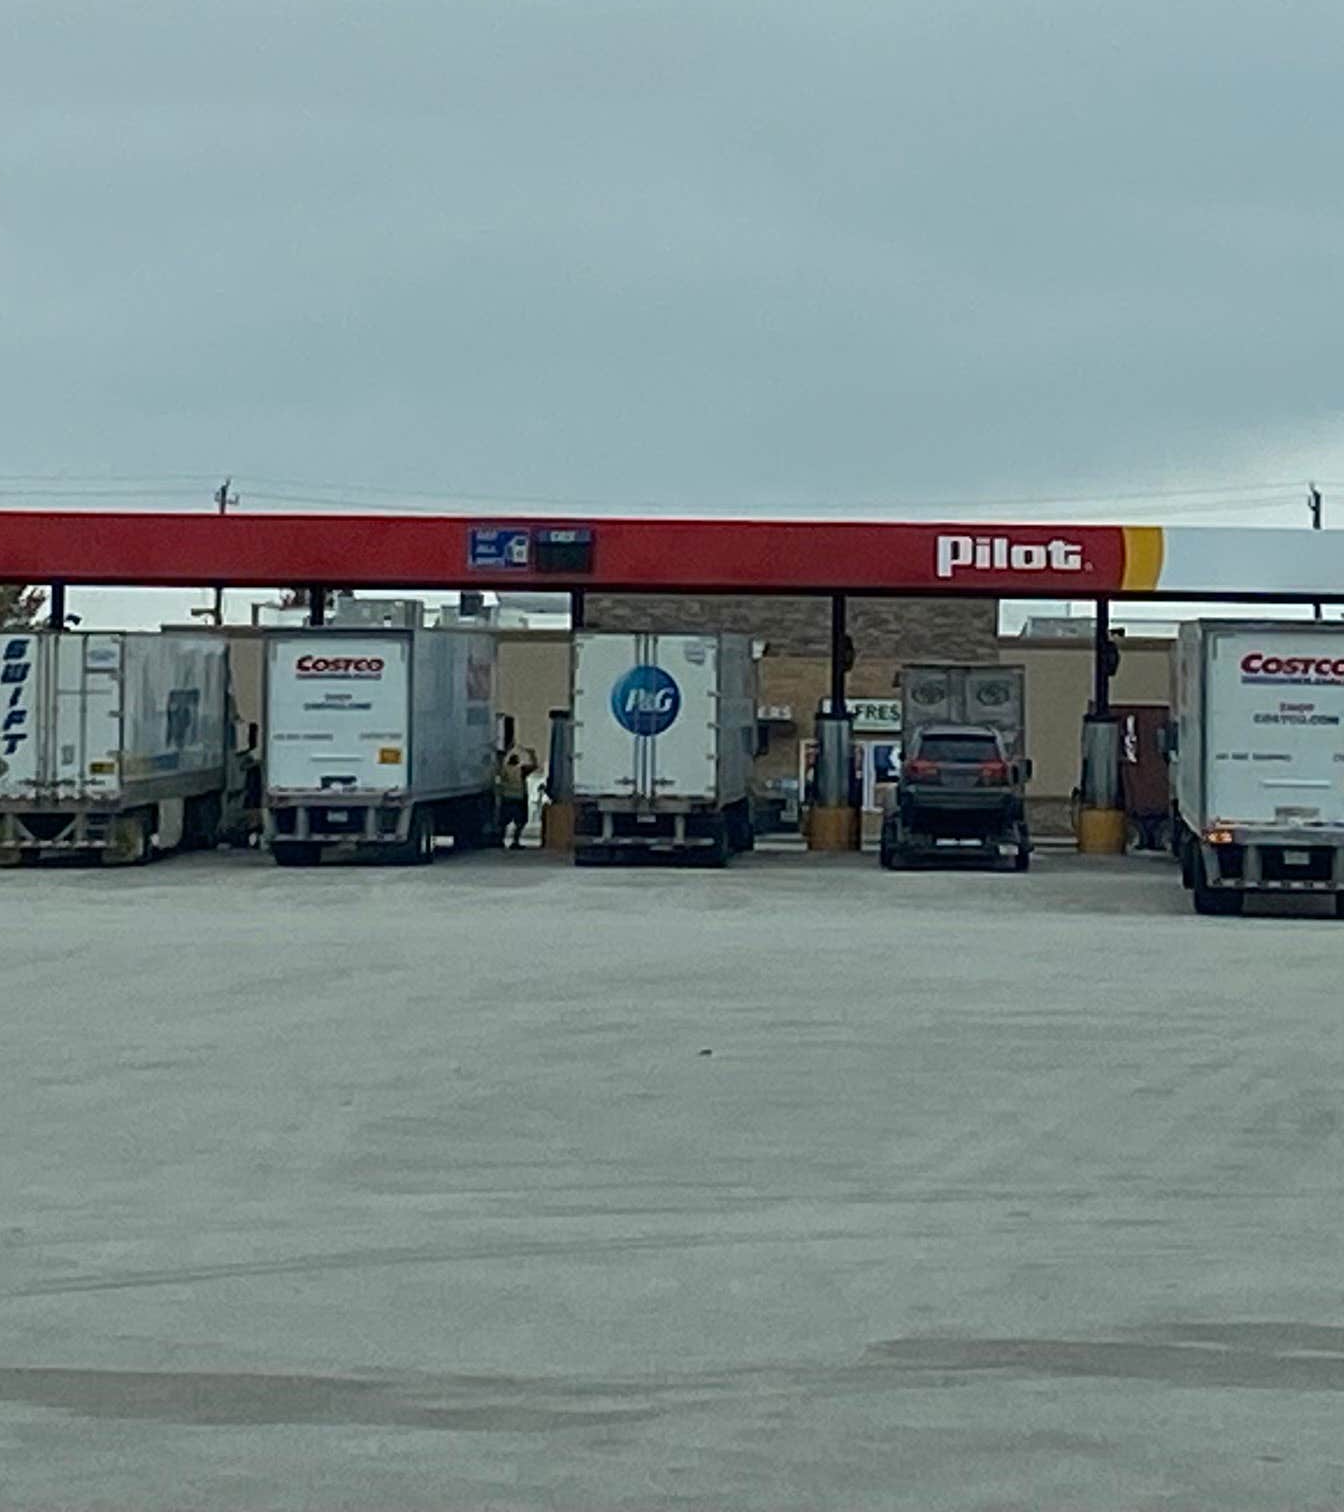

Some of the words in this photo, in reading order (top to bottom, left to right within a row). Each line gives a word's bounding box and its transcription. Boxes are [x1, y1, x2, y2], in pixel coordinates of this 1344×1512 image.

[937, 535, 1083, 578] Pilot
[296, 655, 385, 672] COSTCO
[1, 639, 31, 756] SWIFT
[624, 687, 675, 713] P&G
